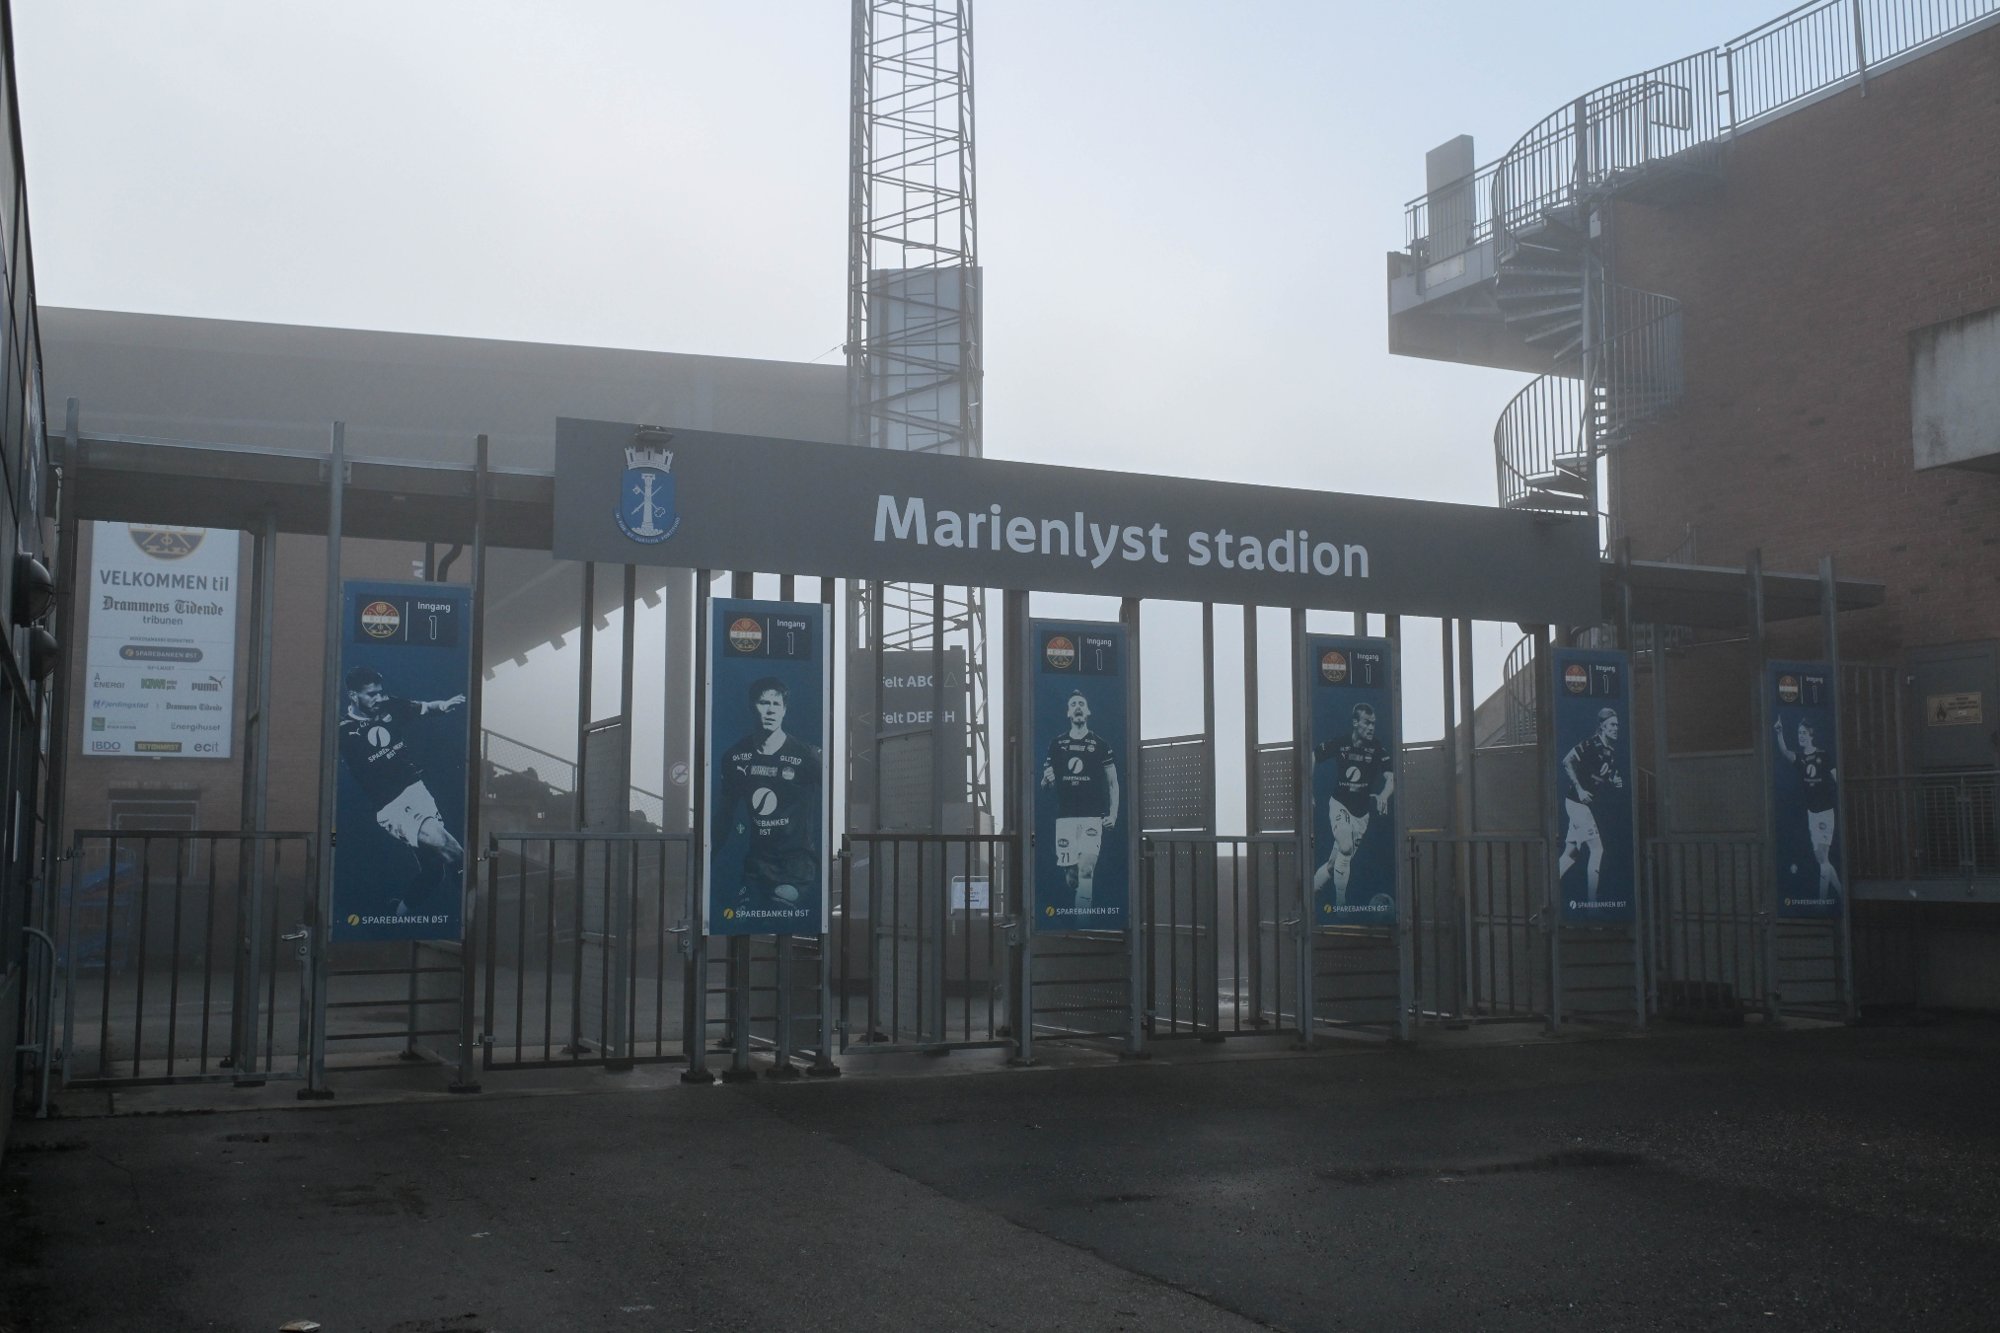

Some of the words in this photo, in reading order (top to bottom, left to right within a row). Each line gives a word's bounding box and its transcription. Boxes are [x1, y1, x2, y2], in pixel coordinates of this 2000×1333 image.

[873, 494, 1169, 569] Marienlyst
[1187, 528, 1369, 578] stadion
[100, 569, 207, 590] VELKOMMEN
[212, 576, 229, 592] til
[102, 595, 170, 613] Drammens
[174, 599, 224, 616] Tidende
[417, 601, 451, 613] Inngang
[143, 615, 183, 626] tribunen
[776, 619, 806, 630] Inngang
[428, 615, 437, 640] 1
[786, 631, 794, 655] 1
[1086, 637, 1112, 647] Inngang
[1356, 653, 1379, 662] Inngang
[94, 681, 125, 689] ENERGI
[141, 678, 166, 690] KIWI
[191, 682, 218, 692] PUMA
[882, 675, 904, 688] elt
[882, 711, 904, 724] elt
[170, 722, 221, 732] Energihuset
[95, 741, 121, 750] BDO
[193, 742, 219, 753] ecit
[1060, 852, 1070, 863] 71
[735, 910, 793, 918] SPAREBANKEN
[794, 909, 810, 918] ØST
[1332, 905, 1376, 913] SPAREBANKEN
[361, 915, 429, 925] SPAREBANKEN
[431, 915, 449, 924] ØST
